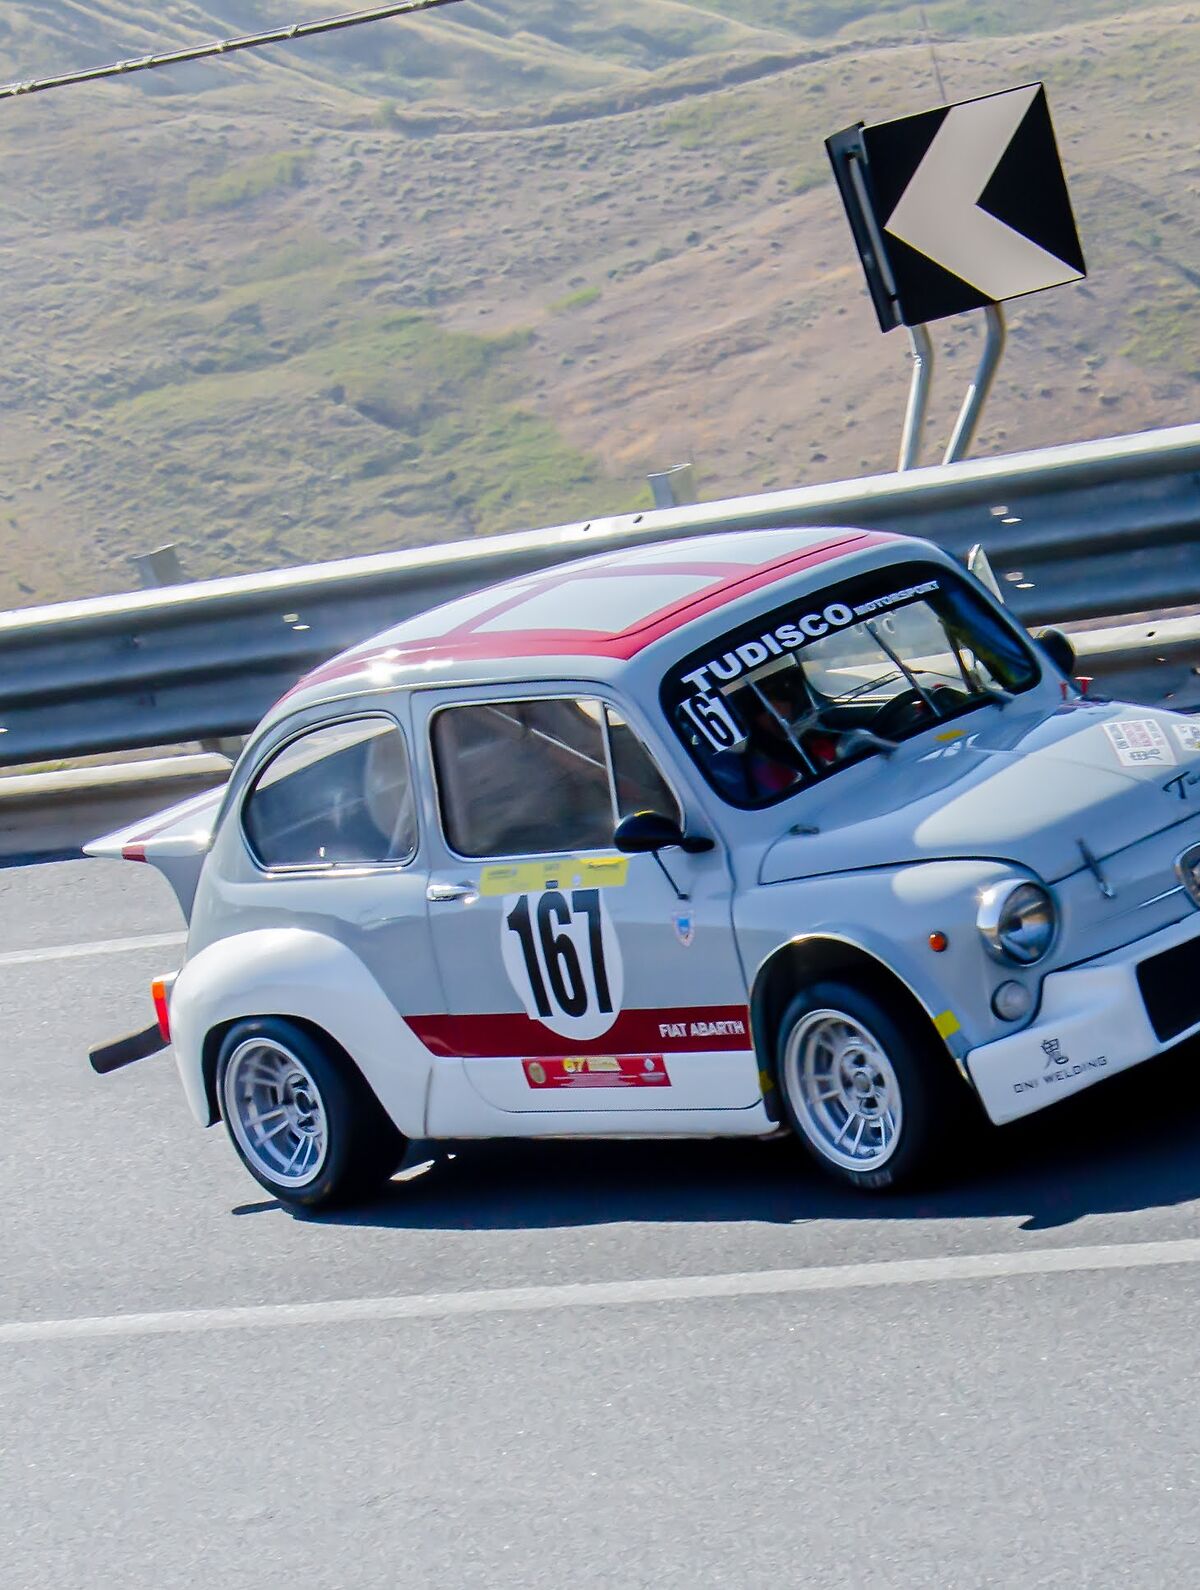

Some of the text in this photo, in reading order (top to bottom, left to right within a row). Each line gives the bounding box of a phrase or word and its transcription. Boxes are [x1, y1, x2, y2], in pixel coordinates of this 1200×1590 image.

[681, 603, 854, 692] TUDISCO
[506, 888, 613, 1018] 167
[658, 1020, 745, 1038] FIAT ABARTH
[1043, 1055, 1107, 1083] WELDING
